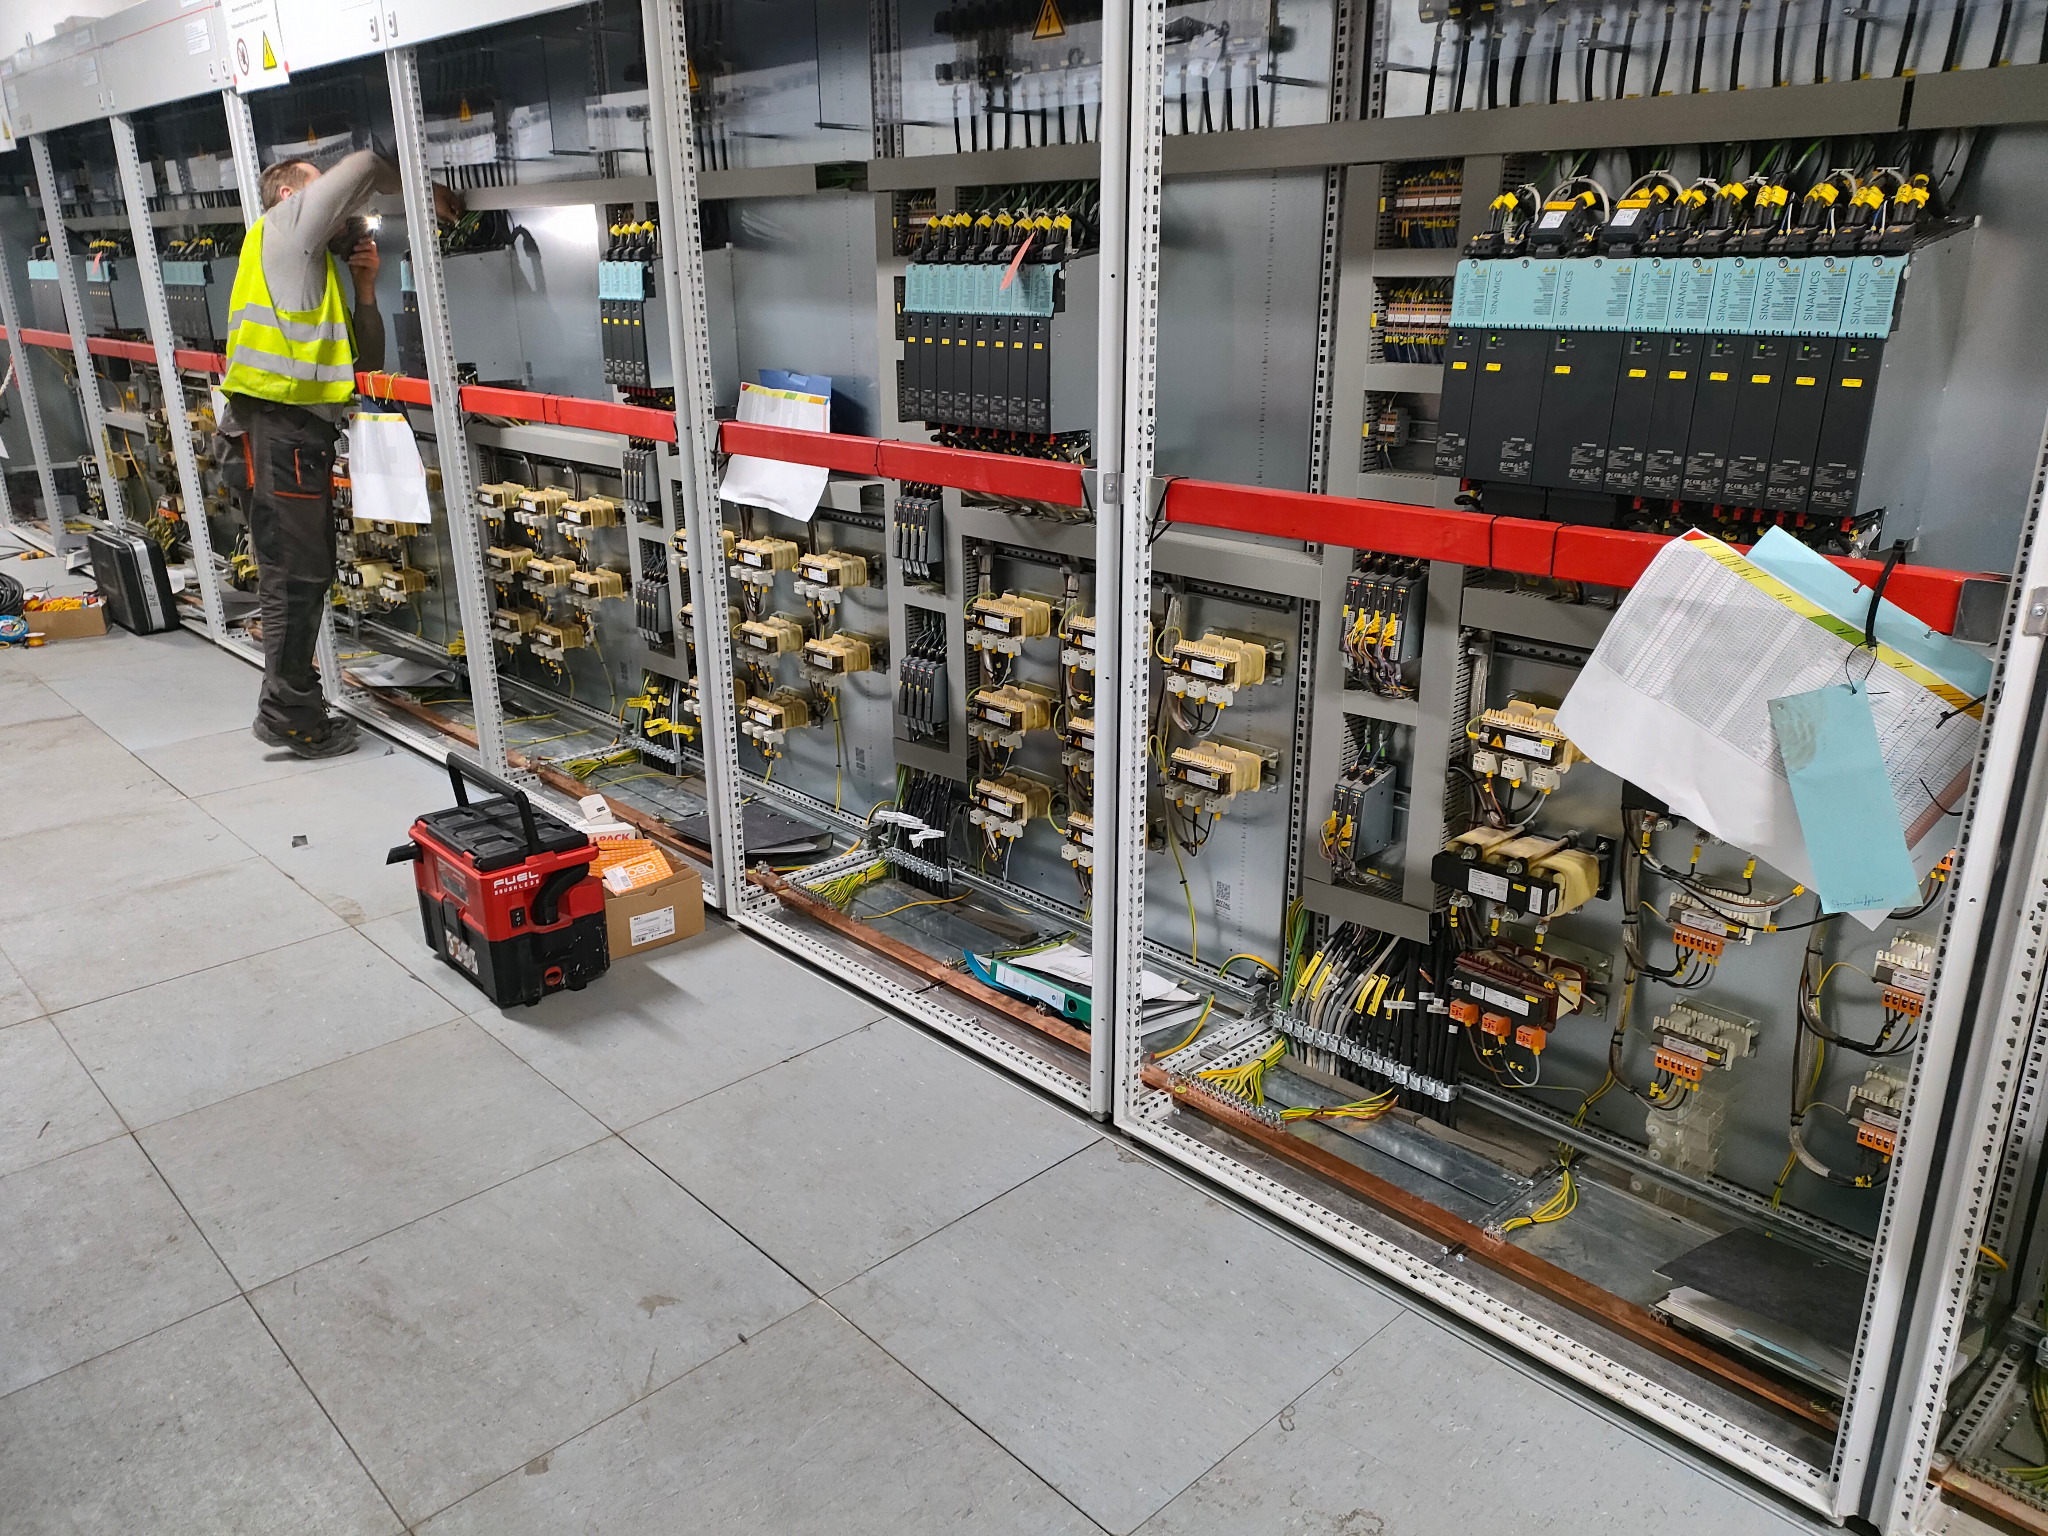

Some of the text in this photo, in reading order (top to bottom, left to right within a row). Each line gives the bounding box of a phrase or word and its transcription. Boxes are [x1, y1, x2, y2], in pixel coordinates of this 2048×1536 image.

[1457, 272, 1469, 316] SINAMICS
[1490, 270, 1502, 315] SINAMICS
[1560, 270, 1574, 316] SINAMICS
[1635, 272, 1650, 320] SINAMICS
[1675, 270, 1690, 319] SINAMICS
[1716, 272, 1732, 321] SINAMICS
[1760, 270, 1776, 321] SINAMICS
[1803, 270, 1820, 321] SINAMICS
[1851, 272, 1869, 324] SINAMICS
[493, 871, 539, 889] FUEL
[494, 879, 540, 896] BRUSHLESS
[626, 863, 656, 877] OBO
